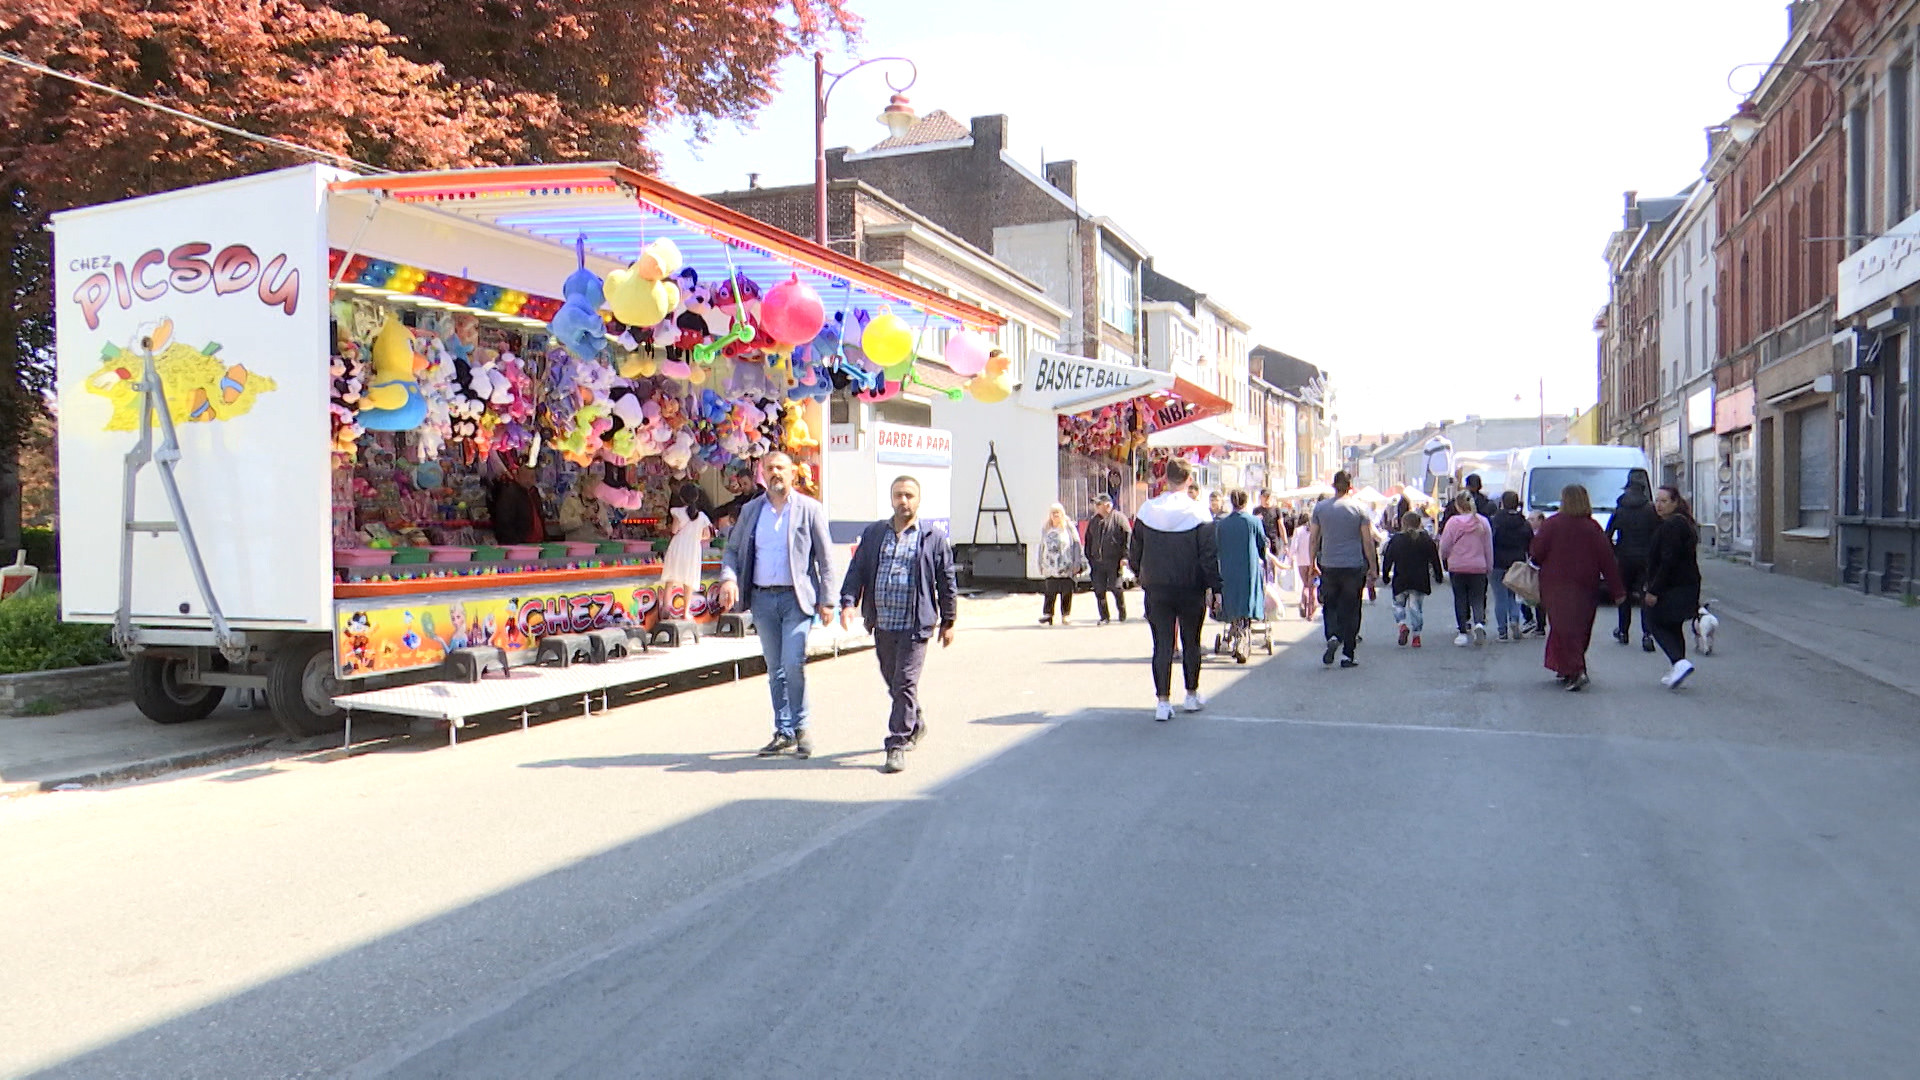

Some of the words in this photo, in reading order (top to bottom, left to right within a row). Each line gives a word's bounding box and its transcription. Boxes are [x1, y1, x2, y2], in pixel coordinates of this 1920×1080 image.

[70, 255, 112, 272] CHEZ
[73, 242, 300, 330] PICSOU
[1035, 357, 1132, 391] BASKET-BALL
[1157, 400, 1195, 426] NBA
[926, 435, 950, 452] PAPA
[518, 592, 615, 638] CHEZ
